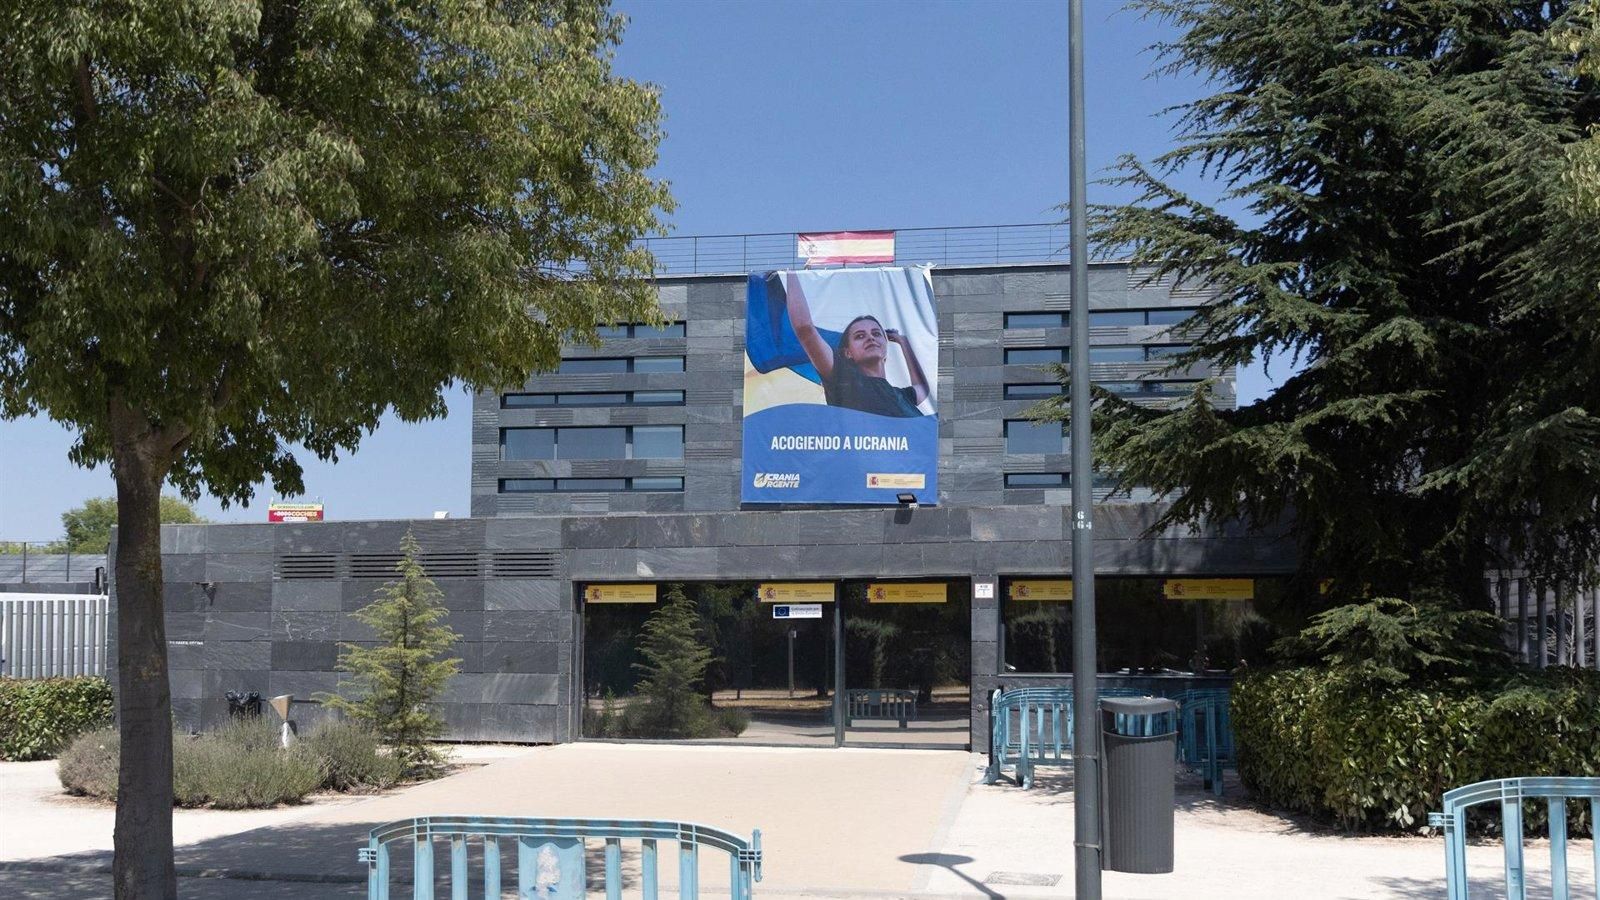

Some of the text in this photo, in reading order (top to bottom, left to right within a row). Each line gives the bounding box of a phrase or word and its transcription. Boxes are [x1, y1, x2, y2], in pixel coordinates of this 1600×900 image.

[771, 436, 908, 451] ACOGIENDO A UCRANIA
[1077, 511, 1084, 519] 6
